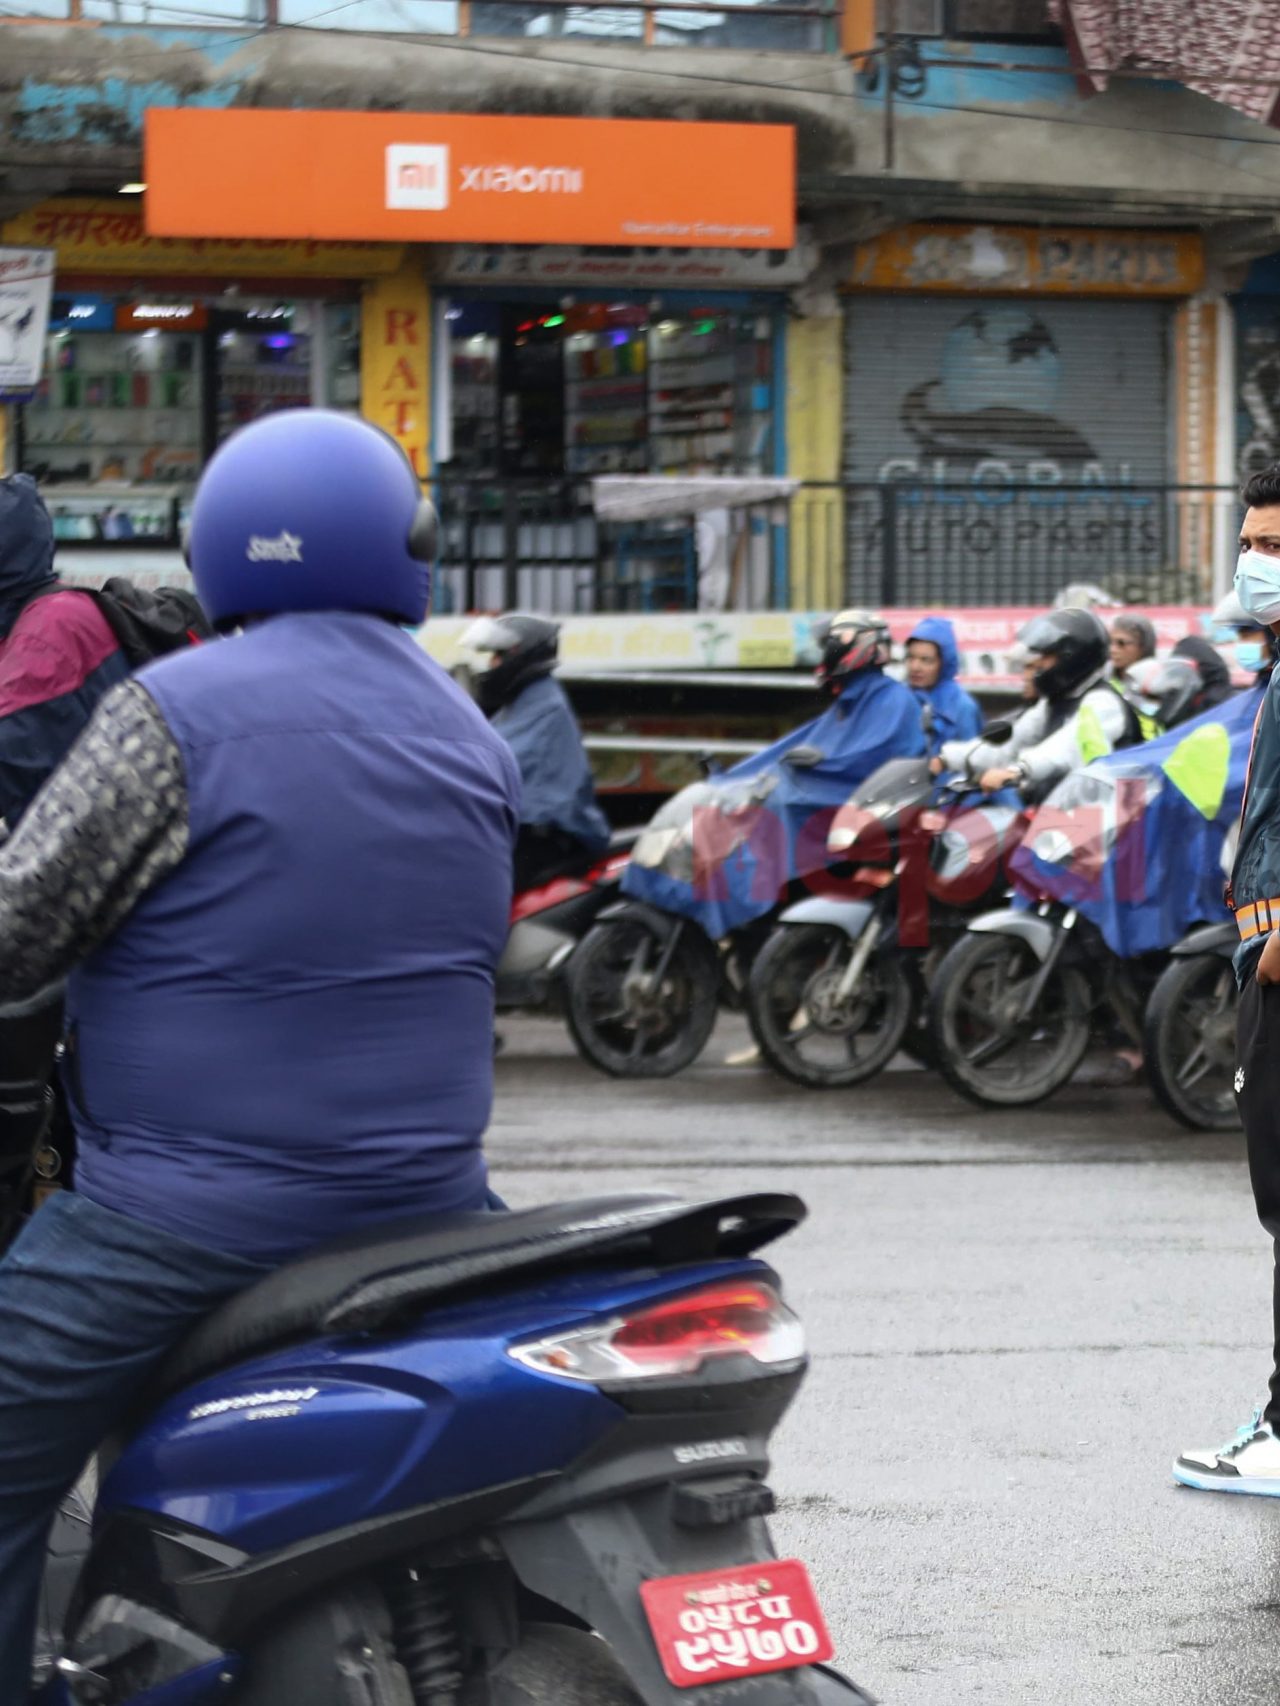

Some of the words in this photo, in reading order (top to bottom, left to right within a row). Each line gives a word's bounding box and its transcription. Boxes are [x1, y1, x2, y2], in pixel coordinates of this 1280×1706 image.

[458, 164, 584, 195] xiaomi
[878, 459, 1152, 506] GLOBAL
[673, 1439, 748, 1464] SUZUKI
